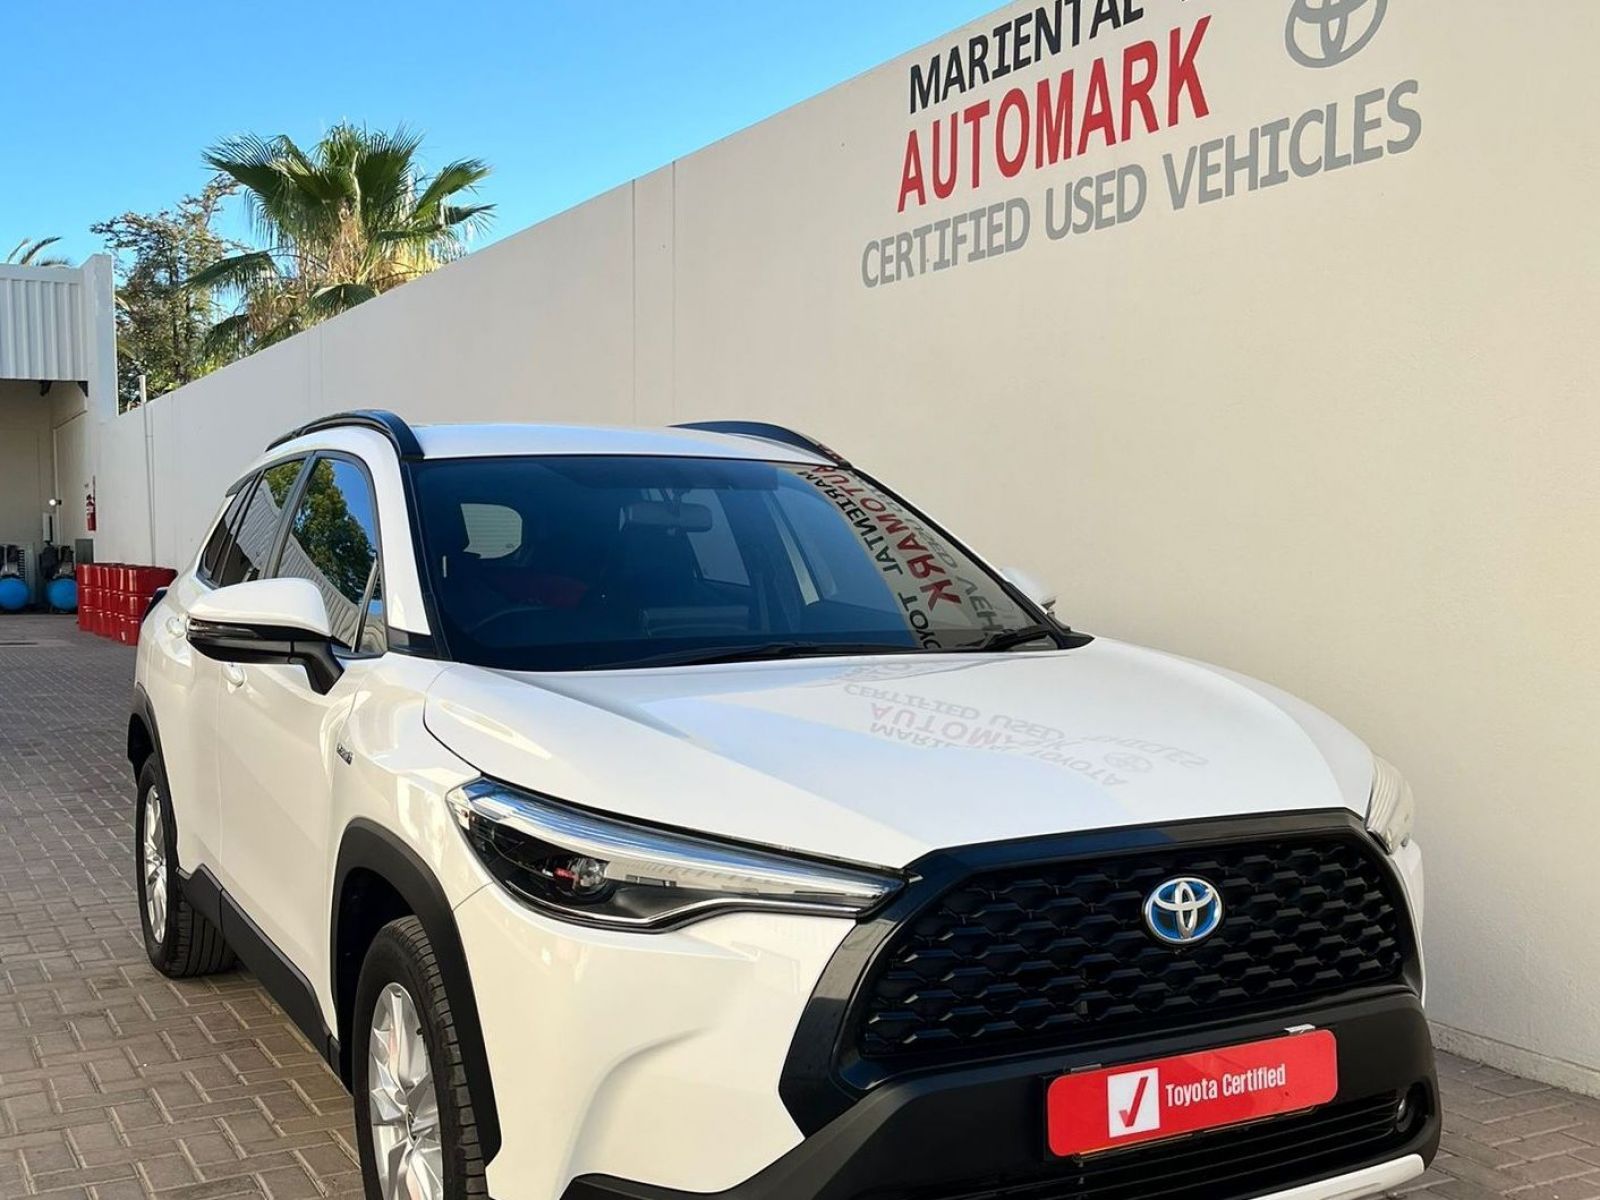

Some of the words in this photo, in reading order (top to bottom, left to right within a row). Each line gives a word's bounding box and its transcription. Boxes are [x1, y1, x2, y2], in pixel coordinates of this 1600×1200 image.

[861, 197, 1031, 289] CERTIFIED
[1045, 164, 1147, 241] USED
[1162, 79, 1423, 211] VEHICLES
[897, 15, 1212, 213] AUTOMARK
[1165, 1079, 1218, 1108] Toyota
[1222, 1063, 1286, 1098] Certified
